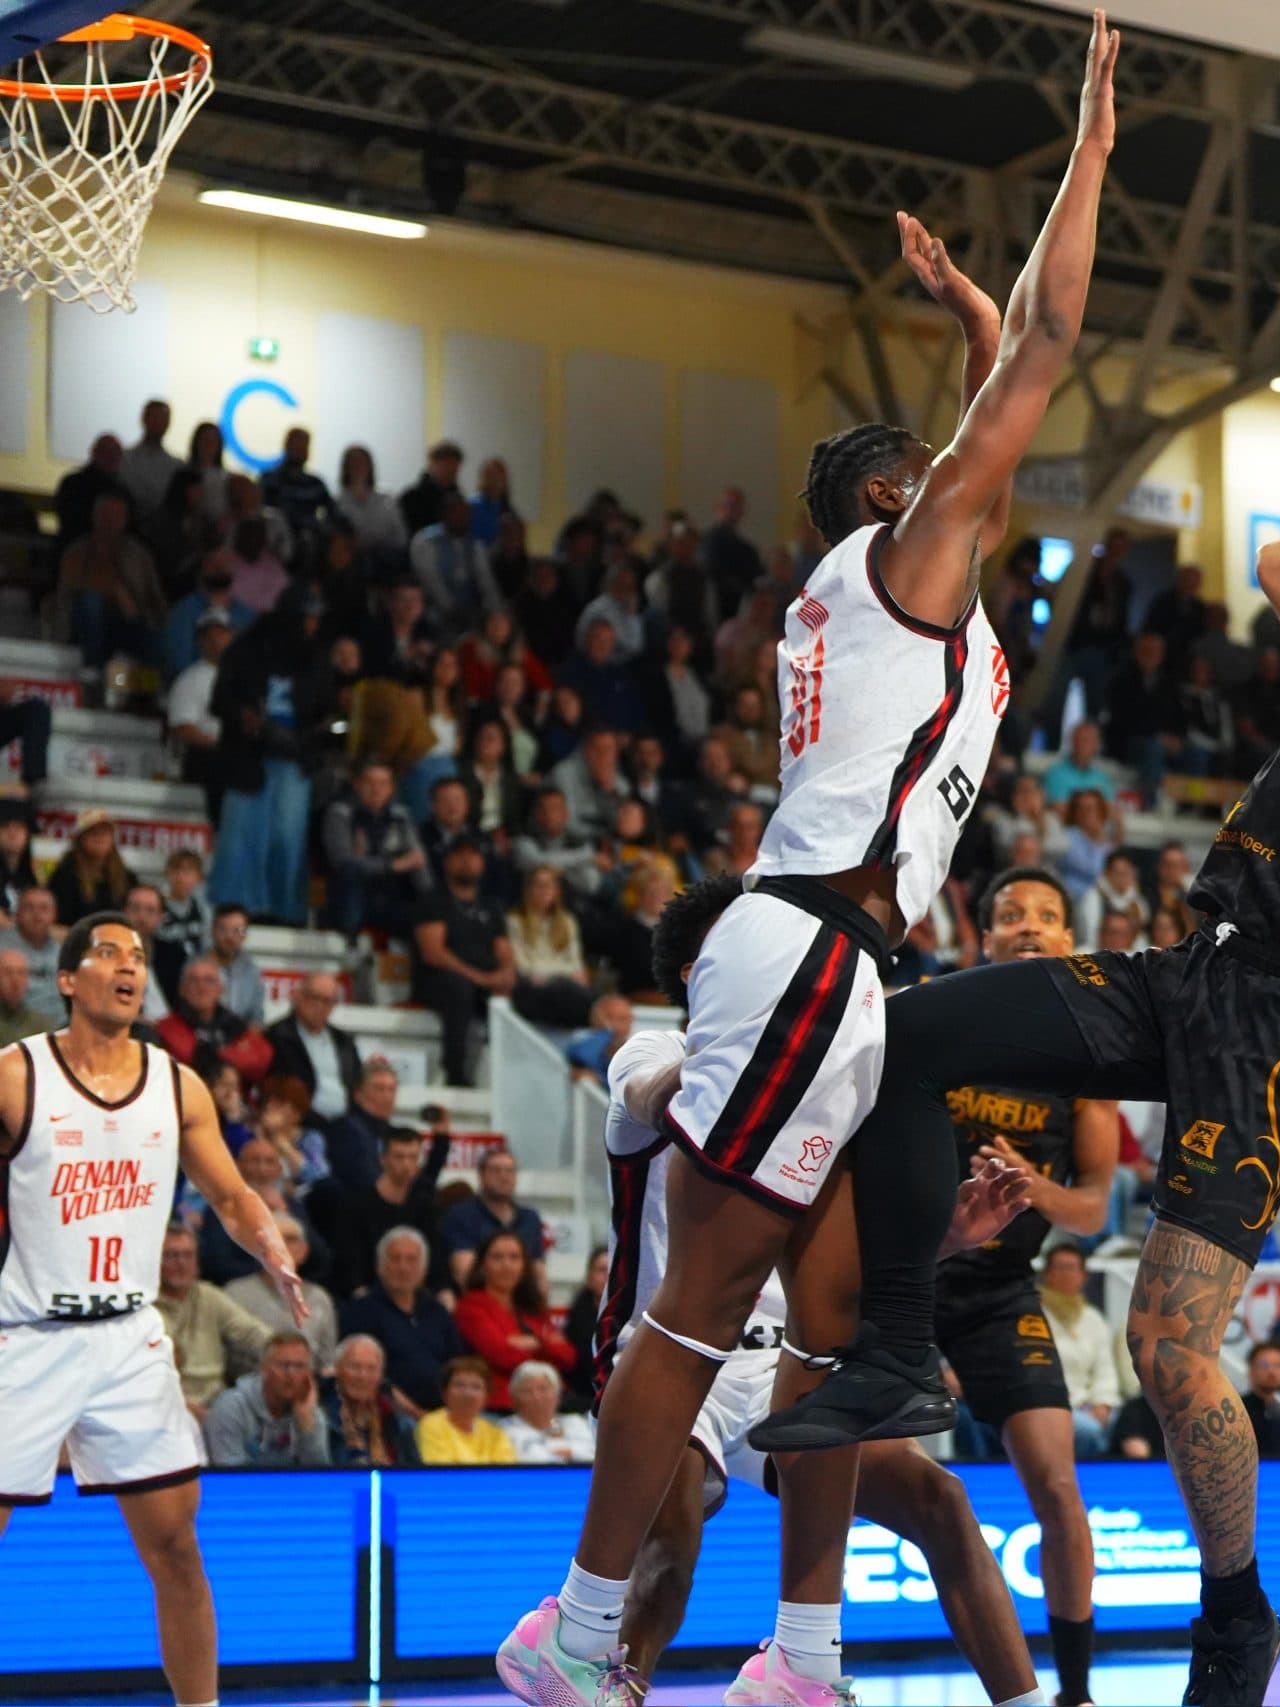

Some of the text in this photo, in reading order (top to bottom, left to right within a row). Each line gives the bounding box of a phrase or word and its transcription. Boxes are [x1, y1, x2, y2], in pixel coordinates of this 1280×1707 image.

[220, 380, 297, 473] C
[50, 1158, 141, 1198] DENAIN
[61, 1181, 157, 1226] VOLTAIRE
[88, 1236, 124, 1283] 18
[47, 1291, 144, 1321] SKF
